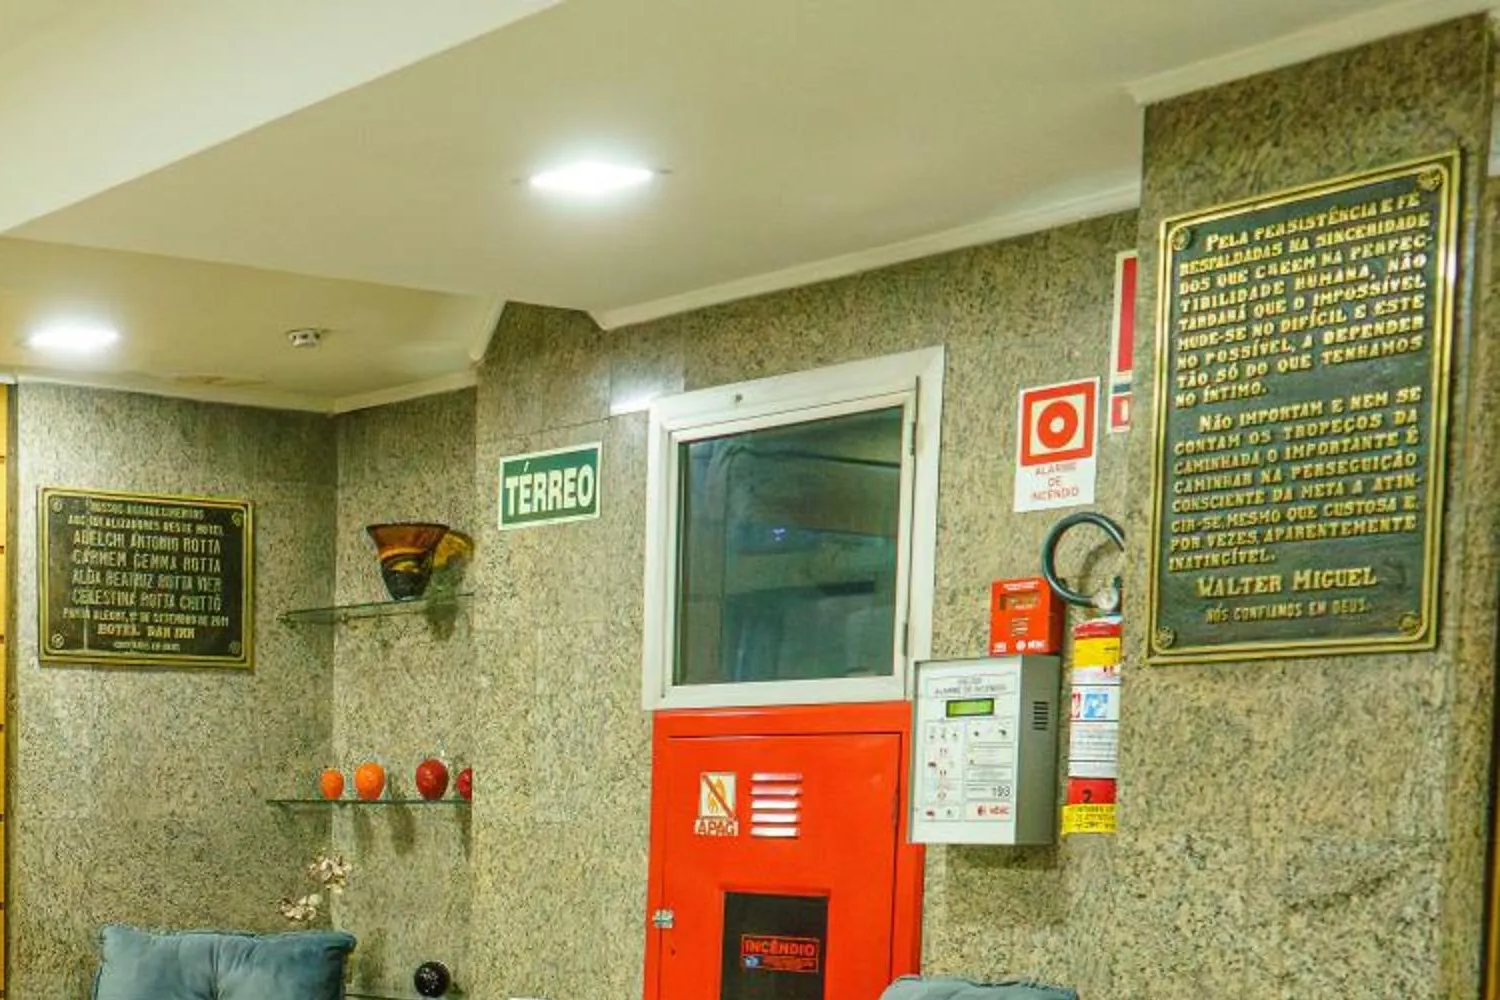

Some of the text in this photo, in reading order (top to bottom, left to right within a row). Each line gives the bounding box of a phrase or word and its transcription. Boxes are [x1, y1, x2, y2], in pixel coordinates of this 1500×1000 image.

[1180, 212, 1430, 277] RESPALDADAS NA SINCERIDADE
[1205, 231, 1249, 252] PELA
[1254, 203, 1377, 240] PERSISTÊNCIA
[1380, 198, 1393, 214] E
[1180, 277, 1211, 295] DOS
[1217, 269, 1248, 287] QUE
[1255, 255, 1316, 279] CREEM
[1321, 250, 1342, 267] NA
[1180, 251, 1427, 313] TIBILIDADE HUMANA, NÃO
[1177, 293, 1425, 351] MUDE-SE NO DIFÍCIL E ESTE
[1178, 274, 1426, 331] TARDARÁ QUE O IMPOSSÍVEL
[1177, 354, 1199, 370] NO
[1302, 334, 1313, 349] A
[1323, 315, 1424, 345] DEPENDER
[1177, 335, 1423, 389] TÃO SÓ DO QUE TENHAMOS
[1175, 381, 1267, 408] NO ÍNTIMO.
[1199, 385, 1422, 432] NÃO IMPORTAM E NEM SE
[1174, 433, 1241, 456] CONTAM
[1248, 430, 1271, 445] OS
[1392, 408, 1418, 424] DA
[1267, 448, 1278, 463] O
[1284, 431, 1399, 460] IMPORTANTE
[505, 461, 595, 516] TÉRREO
[1172, 490, 1265, 513] CONSCIENTE
[1272, 487, 1293, 502] DA
[1301, 481, 1345, 498] META
[1351, 479, 1363, 495] A
[1174, 471, 1253, 494] CAMINHAR
[1260, 467, 1282, 484] NA
[1170, 536, 1201, 552] POR
[1263, 514, 1417, 543] APARENTEMENTE
[1227, 509, 1281, 528] MESMO
[1286, 505, 1318, 521] QUE
[1323, 497, 1397, 517] CUSTOSA
[183, 537, 221, 555] ROTTA
[183, 556, 221, 574] ROTTA
[1308, 600, 1327, 617] EM
